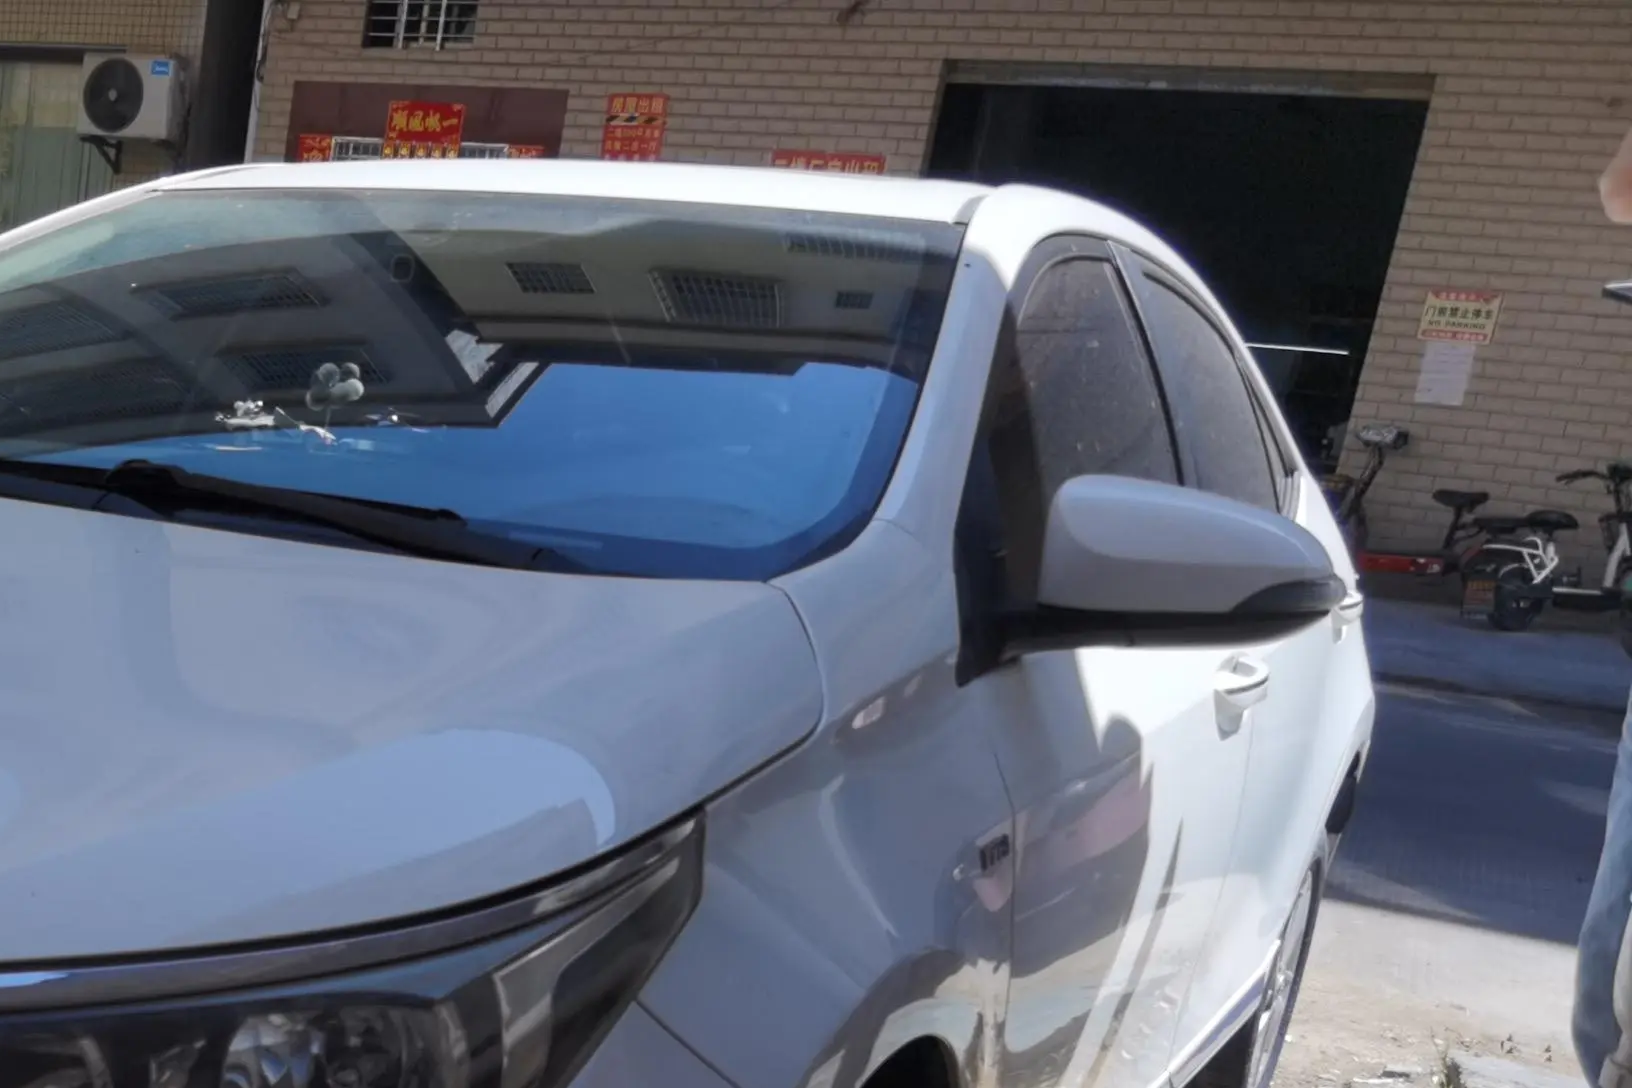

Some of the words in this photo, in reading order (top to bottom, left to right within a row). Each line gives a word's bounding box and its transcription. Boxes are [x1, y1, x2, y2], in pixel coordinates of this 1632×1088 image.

[1425, 305, 1494, 320] 门前禁止停车
[1444, 320, 1486, 330] PARKING
